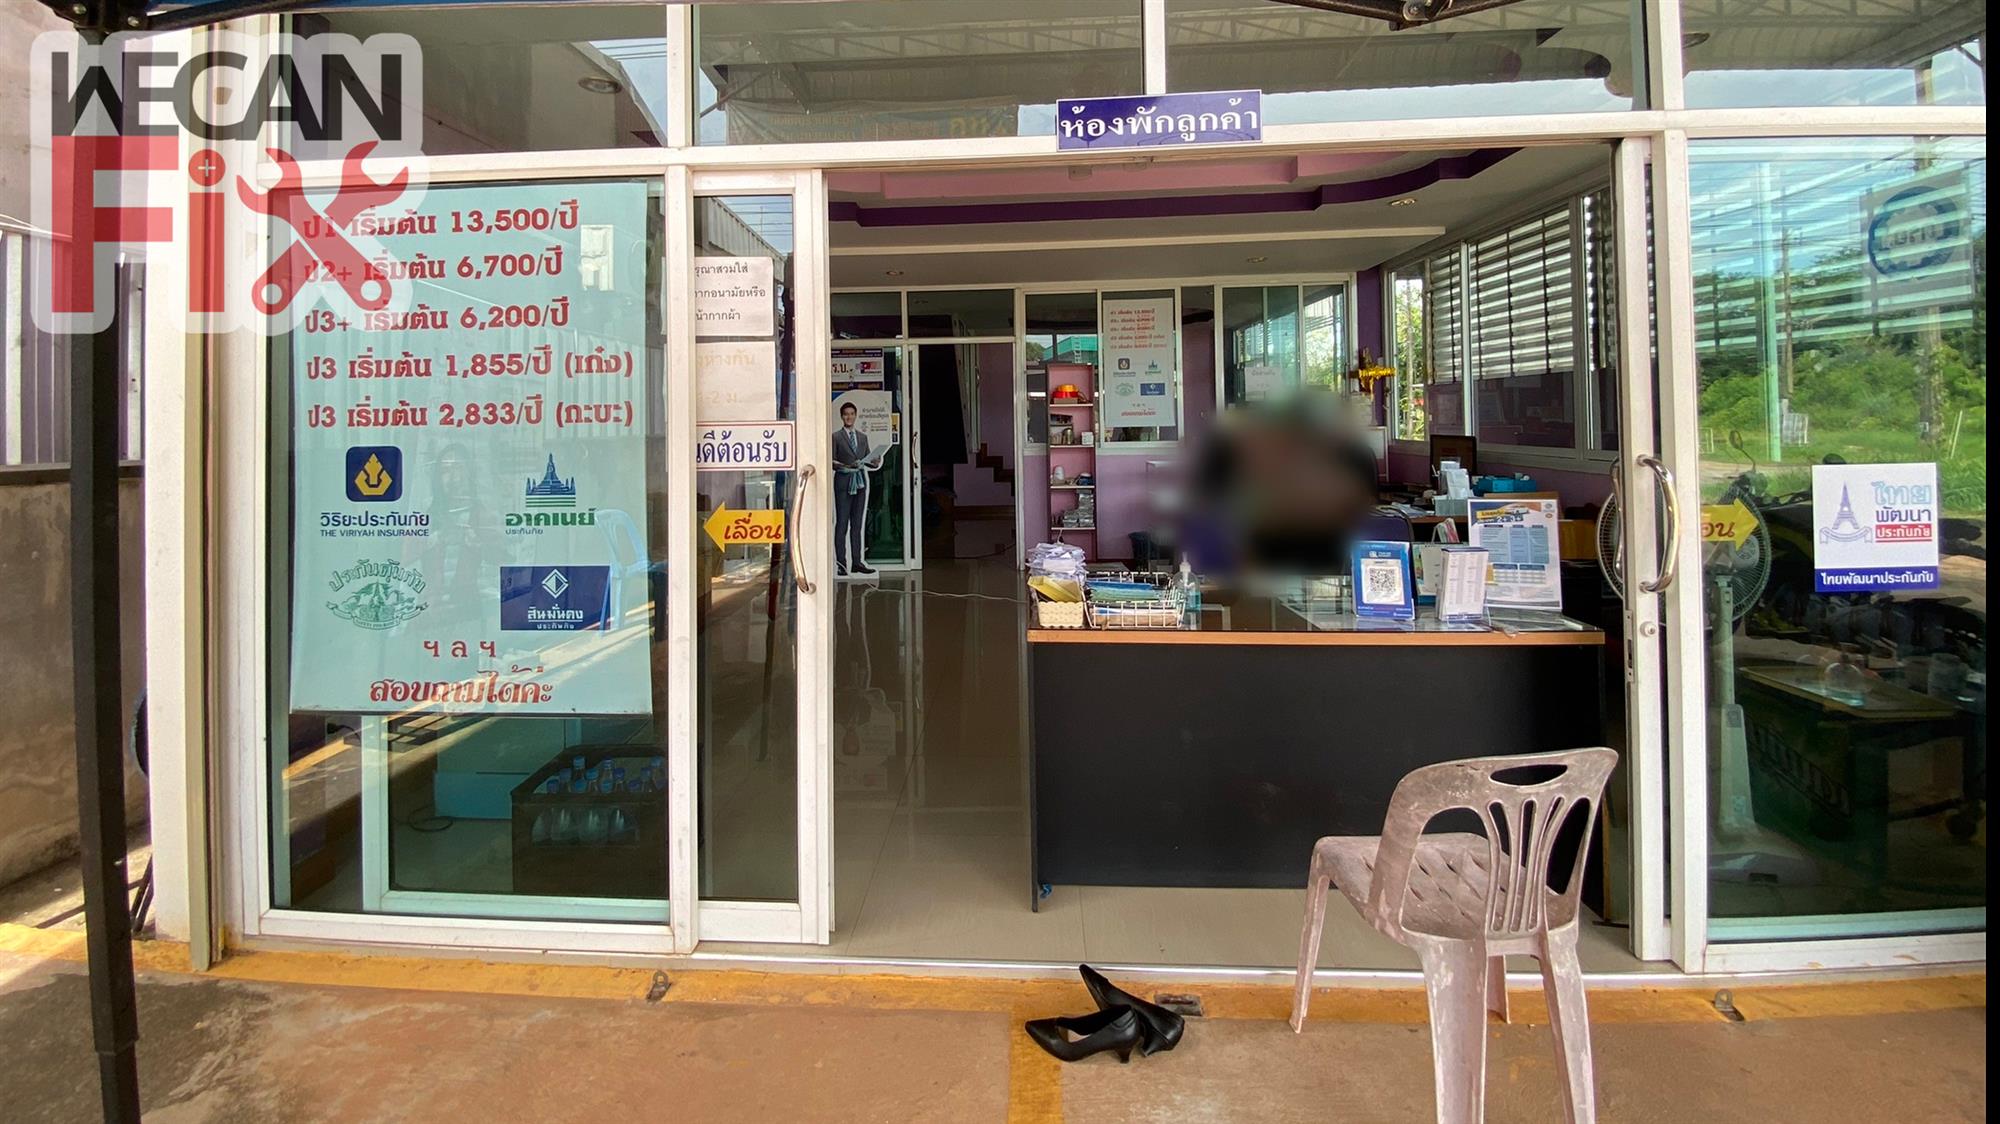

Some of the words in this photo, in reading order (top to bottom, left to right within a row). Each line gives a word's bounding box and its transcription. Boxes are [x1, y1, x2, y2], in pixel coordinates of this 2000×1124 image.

[1060, 97, 1258, 142] ห้องพักลูกค้า
[351, 204, 437, 237] เริ่มต้น
[451, 198, 580, 235] 13,500/ปี
[304, 258, 353, 283] ป2+
[364, 248, 446, 281] เริ่มต้น
[456, 244, 564, 280] 6,700/ปี
[305, 308, 353, 334] ป3+
[364, 298, 449, 331] เริ่มต้น
[460, 295, 570, 331] 6,200/ปี
[306, 355, 337, 380] ป3
[348, 346, 433, 379] เริ่มต้น
[445, 343, 553, 379] 1,855/ปี
[564, 345, 634, 379] (เก๋ง)
[307, 404, 336, 428] ป3
[347, 395, 428, 428] เริ่มต้น
[439, 393, 544, 428] 2,833/ปี
[555, 400, 634, 428] (กะบะ)
[1871, 480, 1932, 505] ไทย
[319, 510, 430, 527] วิริยะประกันภัย
[505, 507, 597, 527] อาคเนย์
[723, 512, 782, 540] เลื่อน
[1875, 506, 1932, 523] พัฒนา
[320, 529, 337, 537] THE
[340, 529, 375, 537] VIRIYAH
[377, 529, 430, 537] INSURANCE
[1877, 524, 1931, 538] ประกันภัย
[1820, 570, 1934, 586] ไทยพัฒนาประกันภัย
[527, 603, 583, 620] สินมั่นคง
